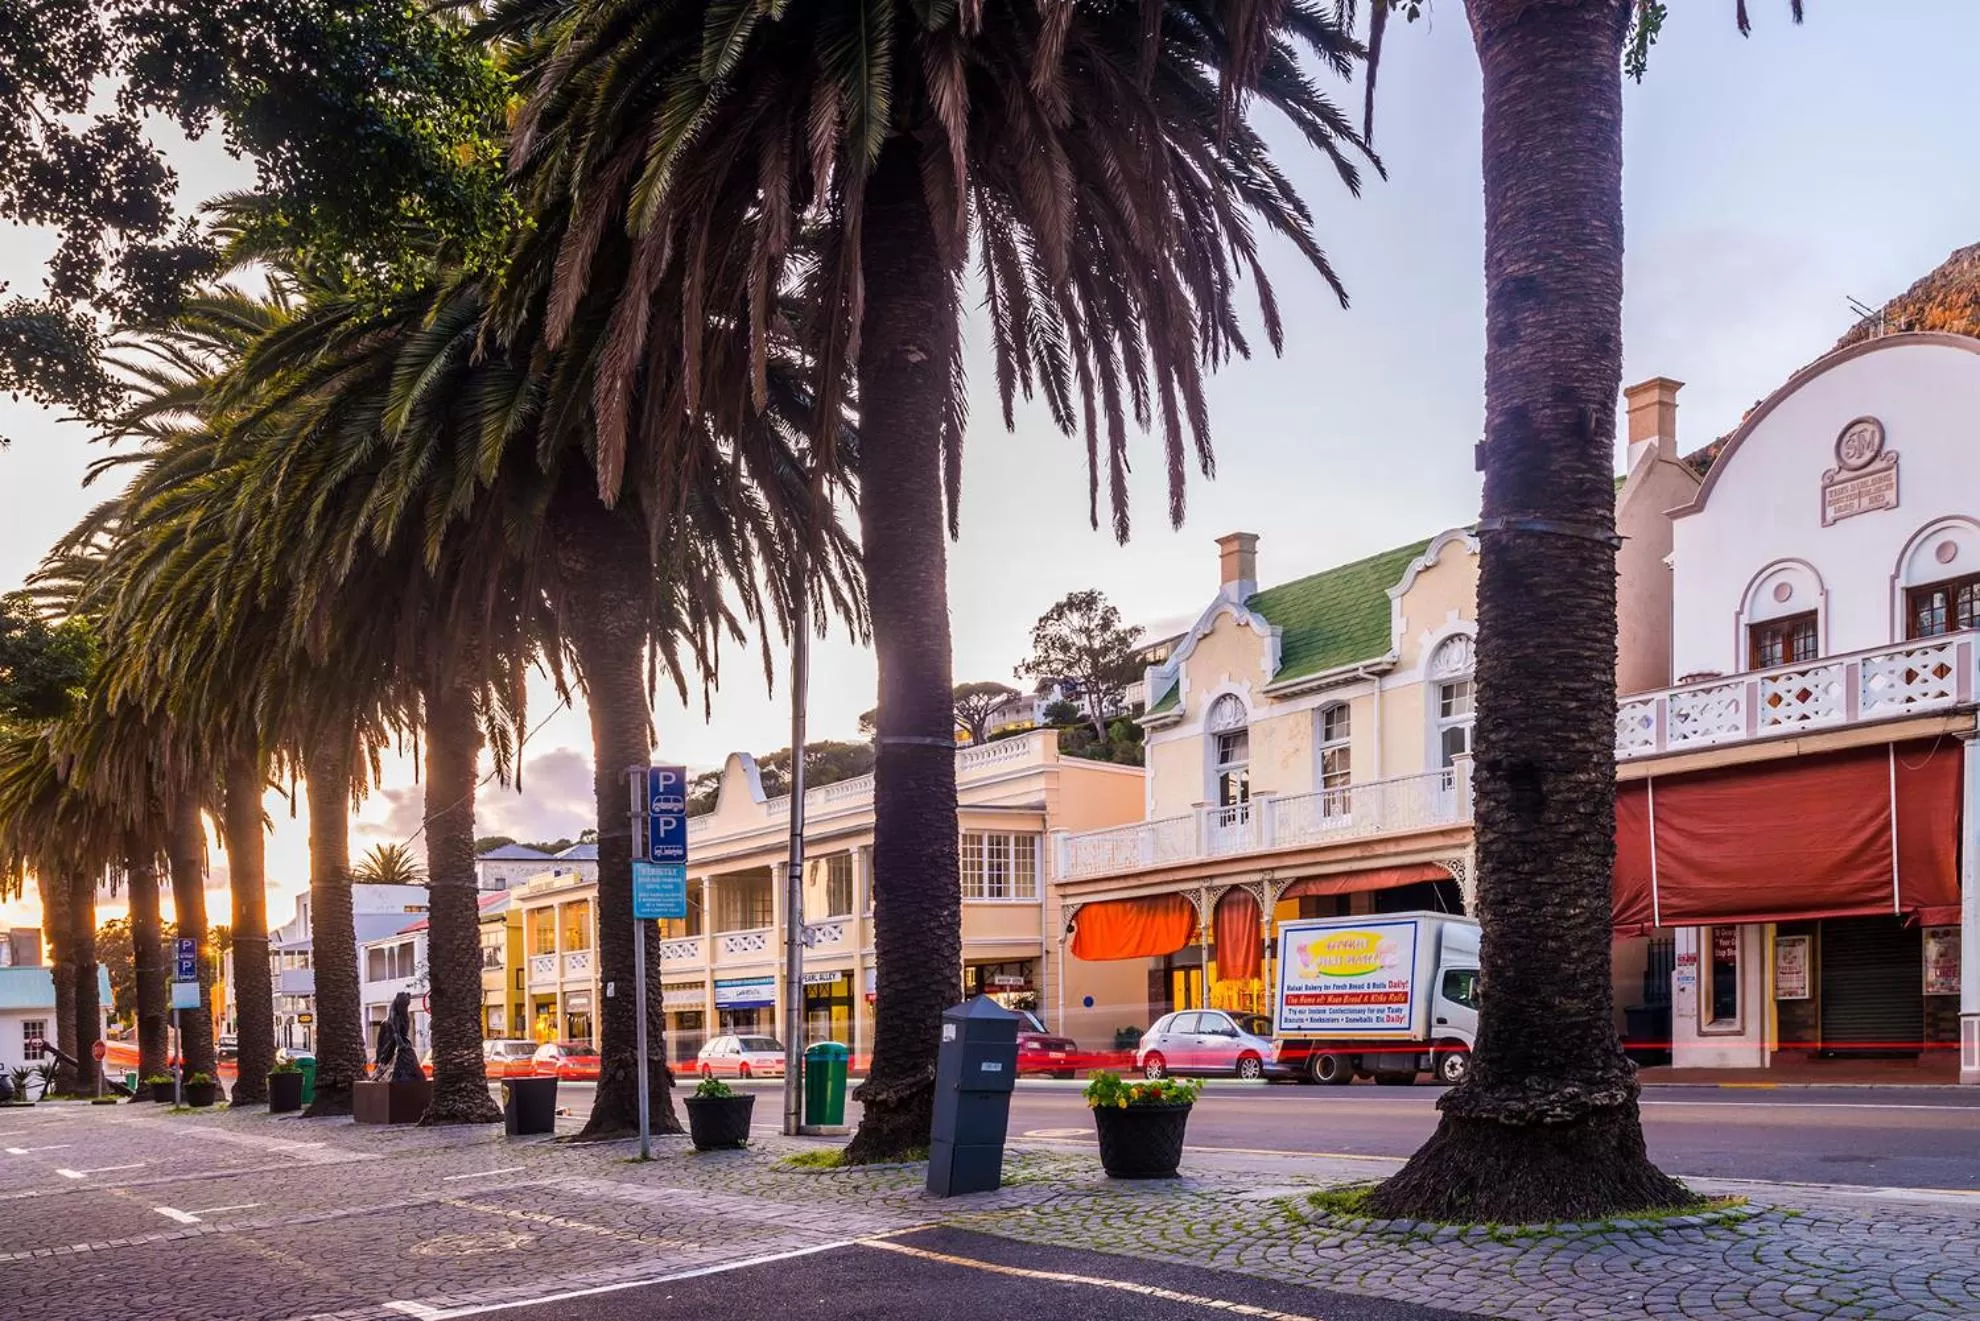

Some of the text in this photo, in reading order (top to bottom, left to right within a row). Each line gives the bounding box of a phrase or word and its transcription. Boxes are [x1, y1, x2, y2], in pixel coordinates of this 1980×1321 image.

[659, 772, 676, 793] P
[660, 817, 677, 838] P
[183, 940, 192, 950] P
[183, 961, 192, 971] P
[1305, 984, 1322, 992] Bakery
[1333, 983, 1347, 991] Fresh
[1373, 981, 1386, 989] Rolls
[1388, 979, 1409, 990] Daily!
[1345, 1015, 1373, 1023] Snowballs
